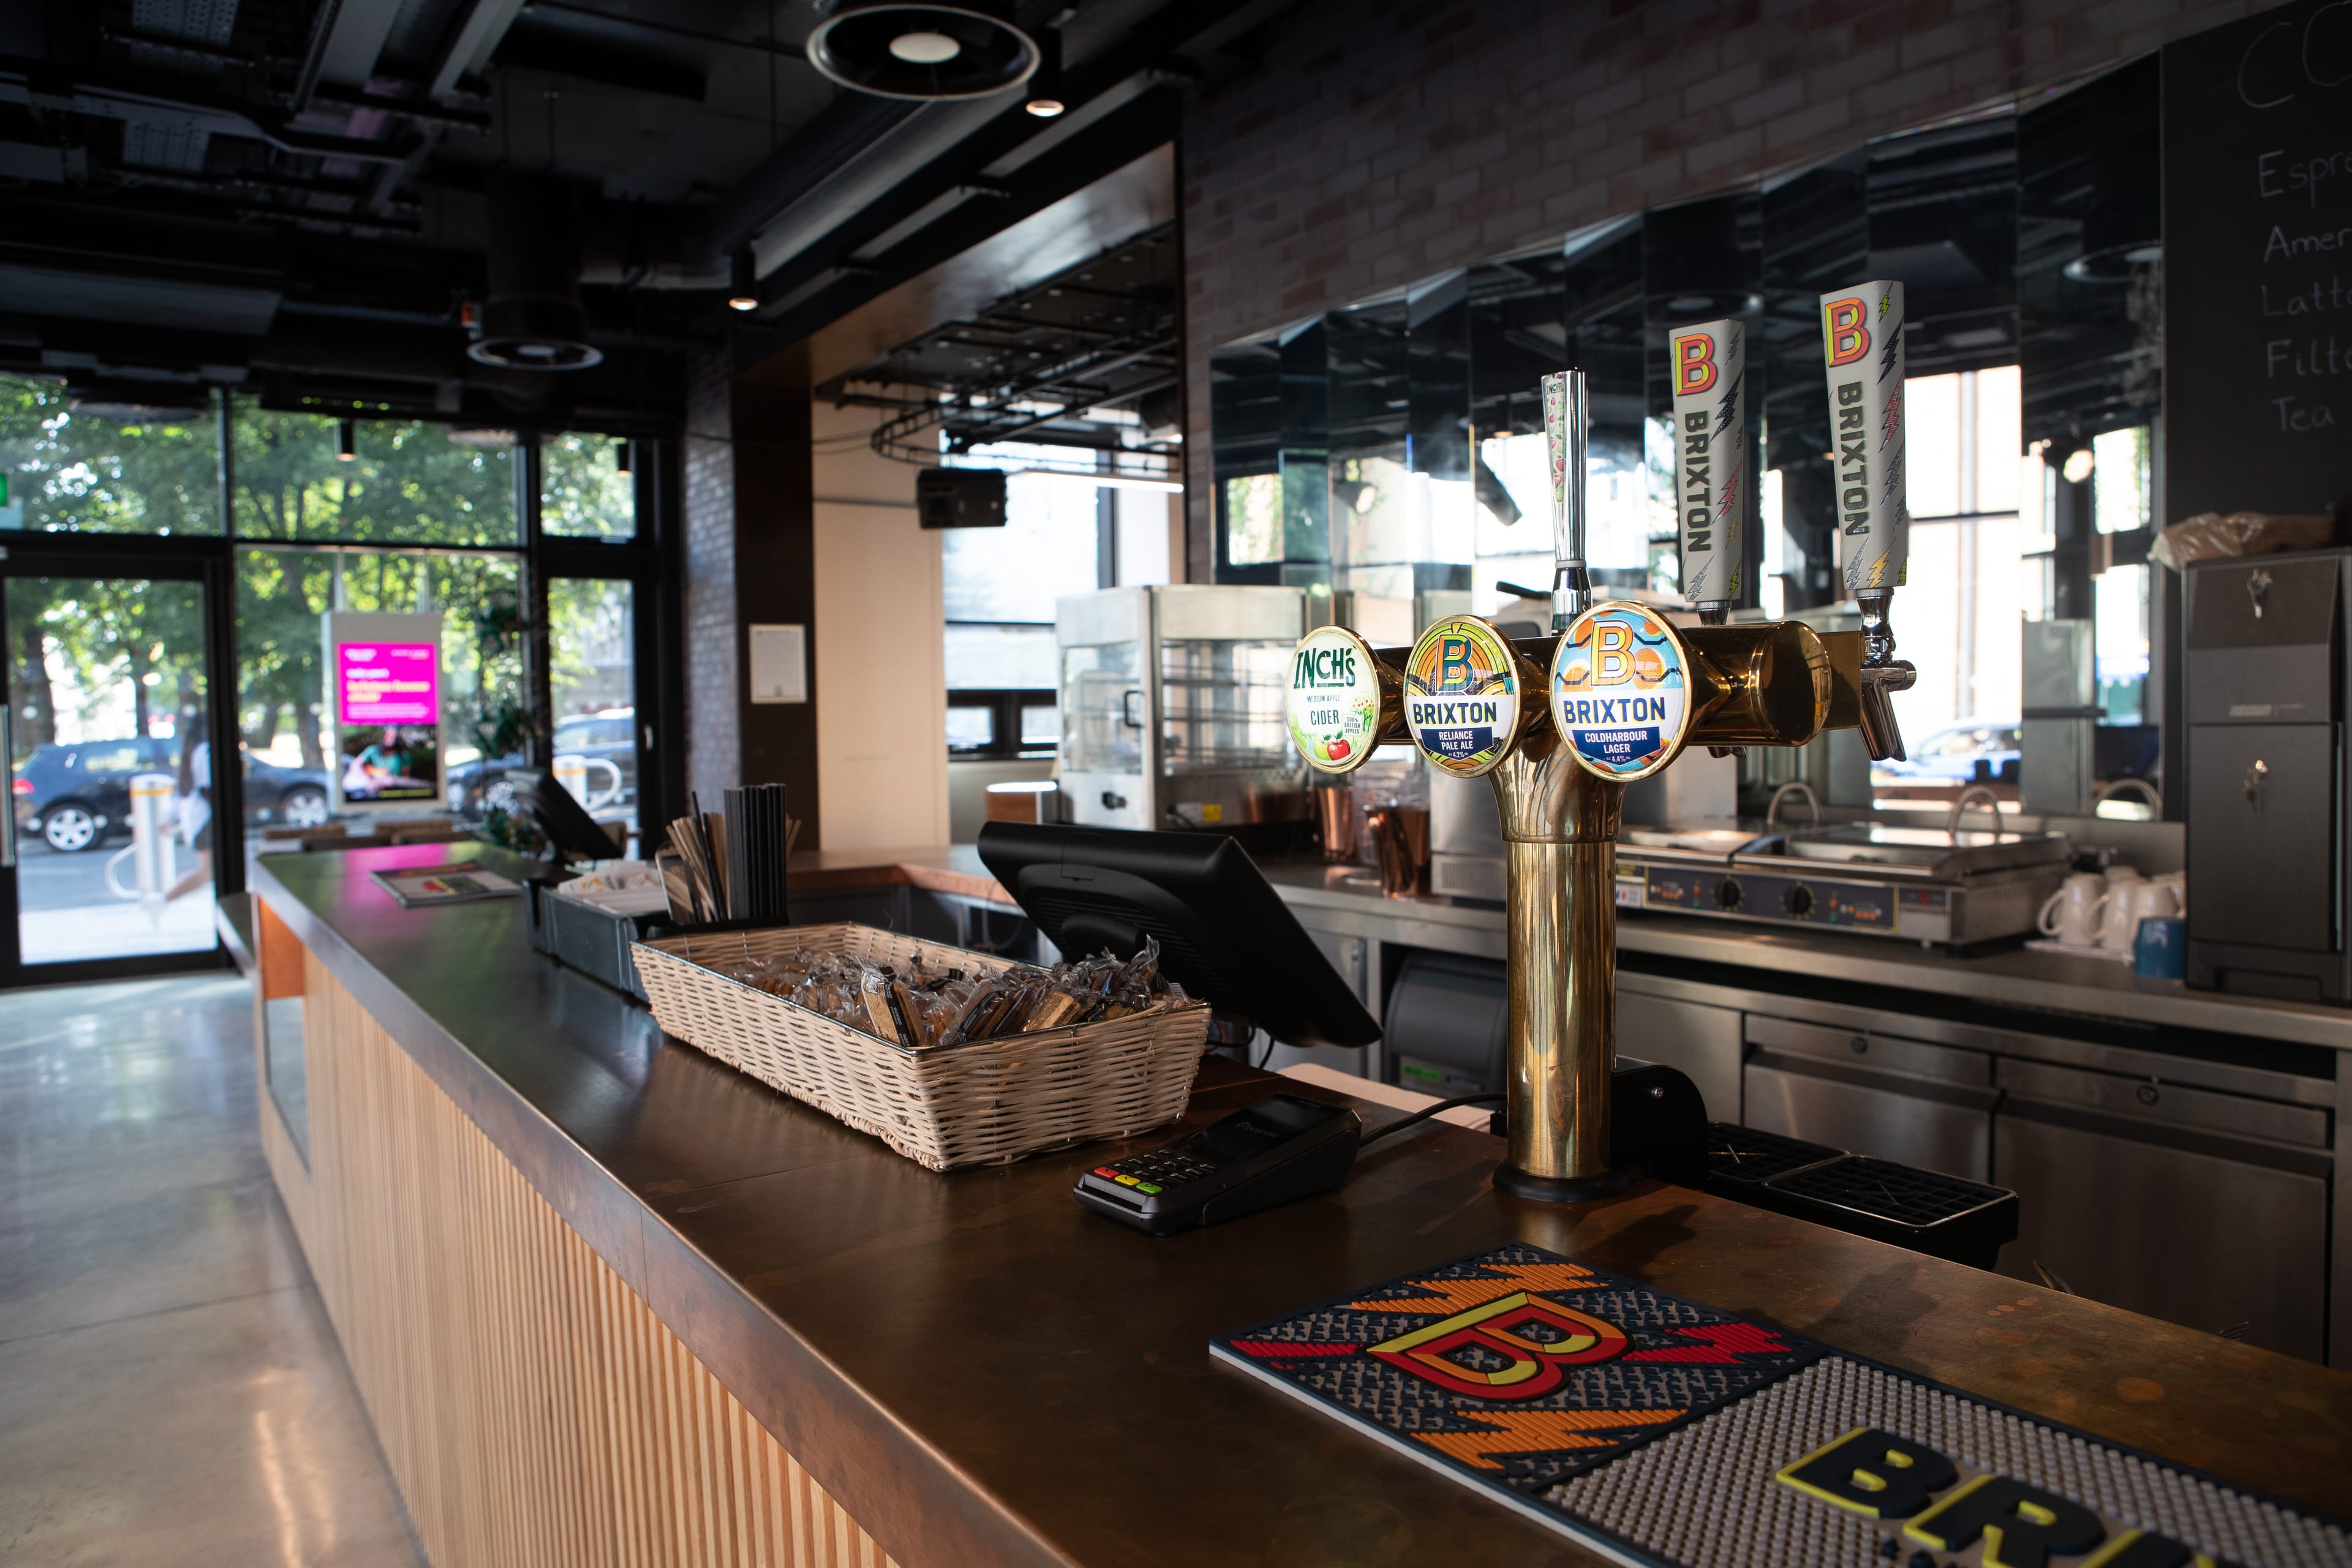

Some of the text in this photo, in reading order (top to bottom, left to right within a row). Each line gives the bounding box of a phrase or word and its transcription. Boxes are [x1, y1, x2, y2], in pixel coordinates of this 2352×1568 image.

[2263, 225, 2352, 263] Amer
[1825, 297, 1871, 368] B
[1675, 333, 1719, 396] B
[2271, 396, 2337, 433] Tea
[1838, 380, 1869, 537] BRIXTON
[1684, 409, 1712, 552] BRIXTON
[1294, 645, 1357, 689] INCH'S
[1435, 634, 1474, 692] B
[1591, 620, 1636, 687] B
[1310, 709, 1340, 725] CIDER
[1412, 702, 1497, 726] BRIXTON
[1562, 696, 1666, 725] BRIXTON
[1439, 730, 1474, 741] RELIANCE
[1441, 740, 1474, 750] PALE ALE
[1585, 730, 1648, 743] COLDHARBOUR
[1604, 743, 1631, 754] LAGER
[1364, 1291, 1636, 1404] B
